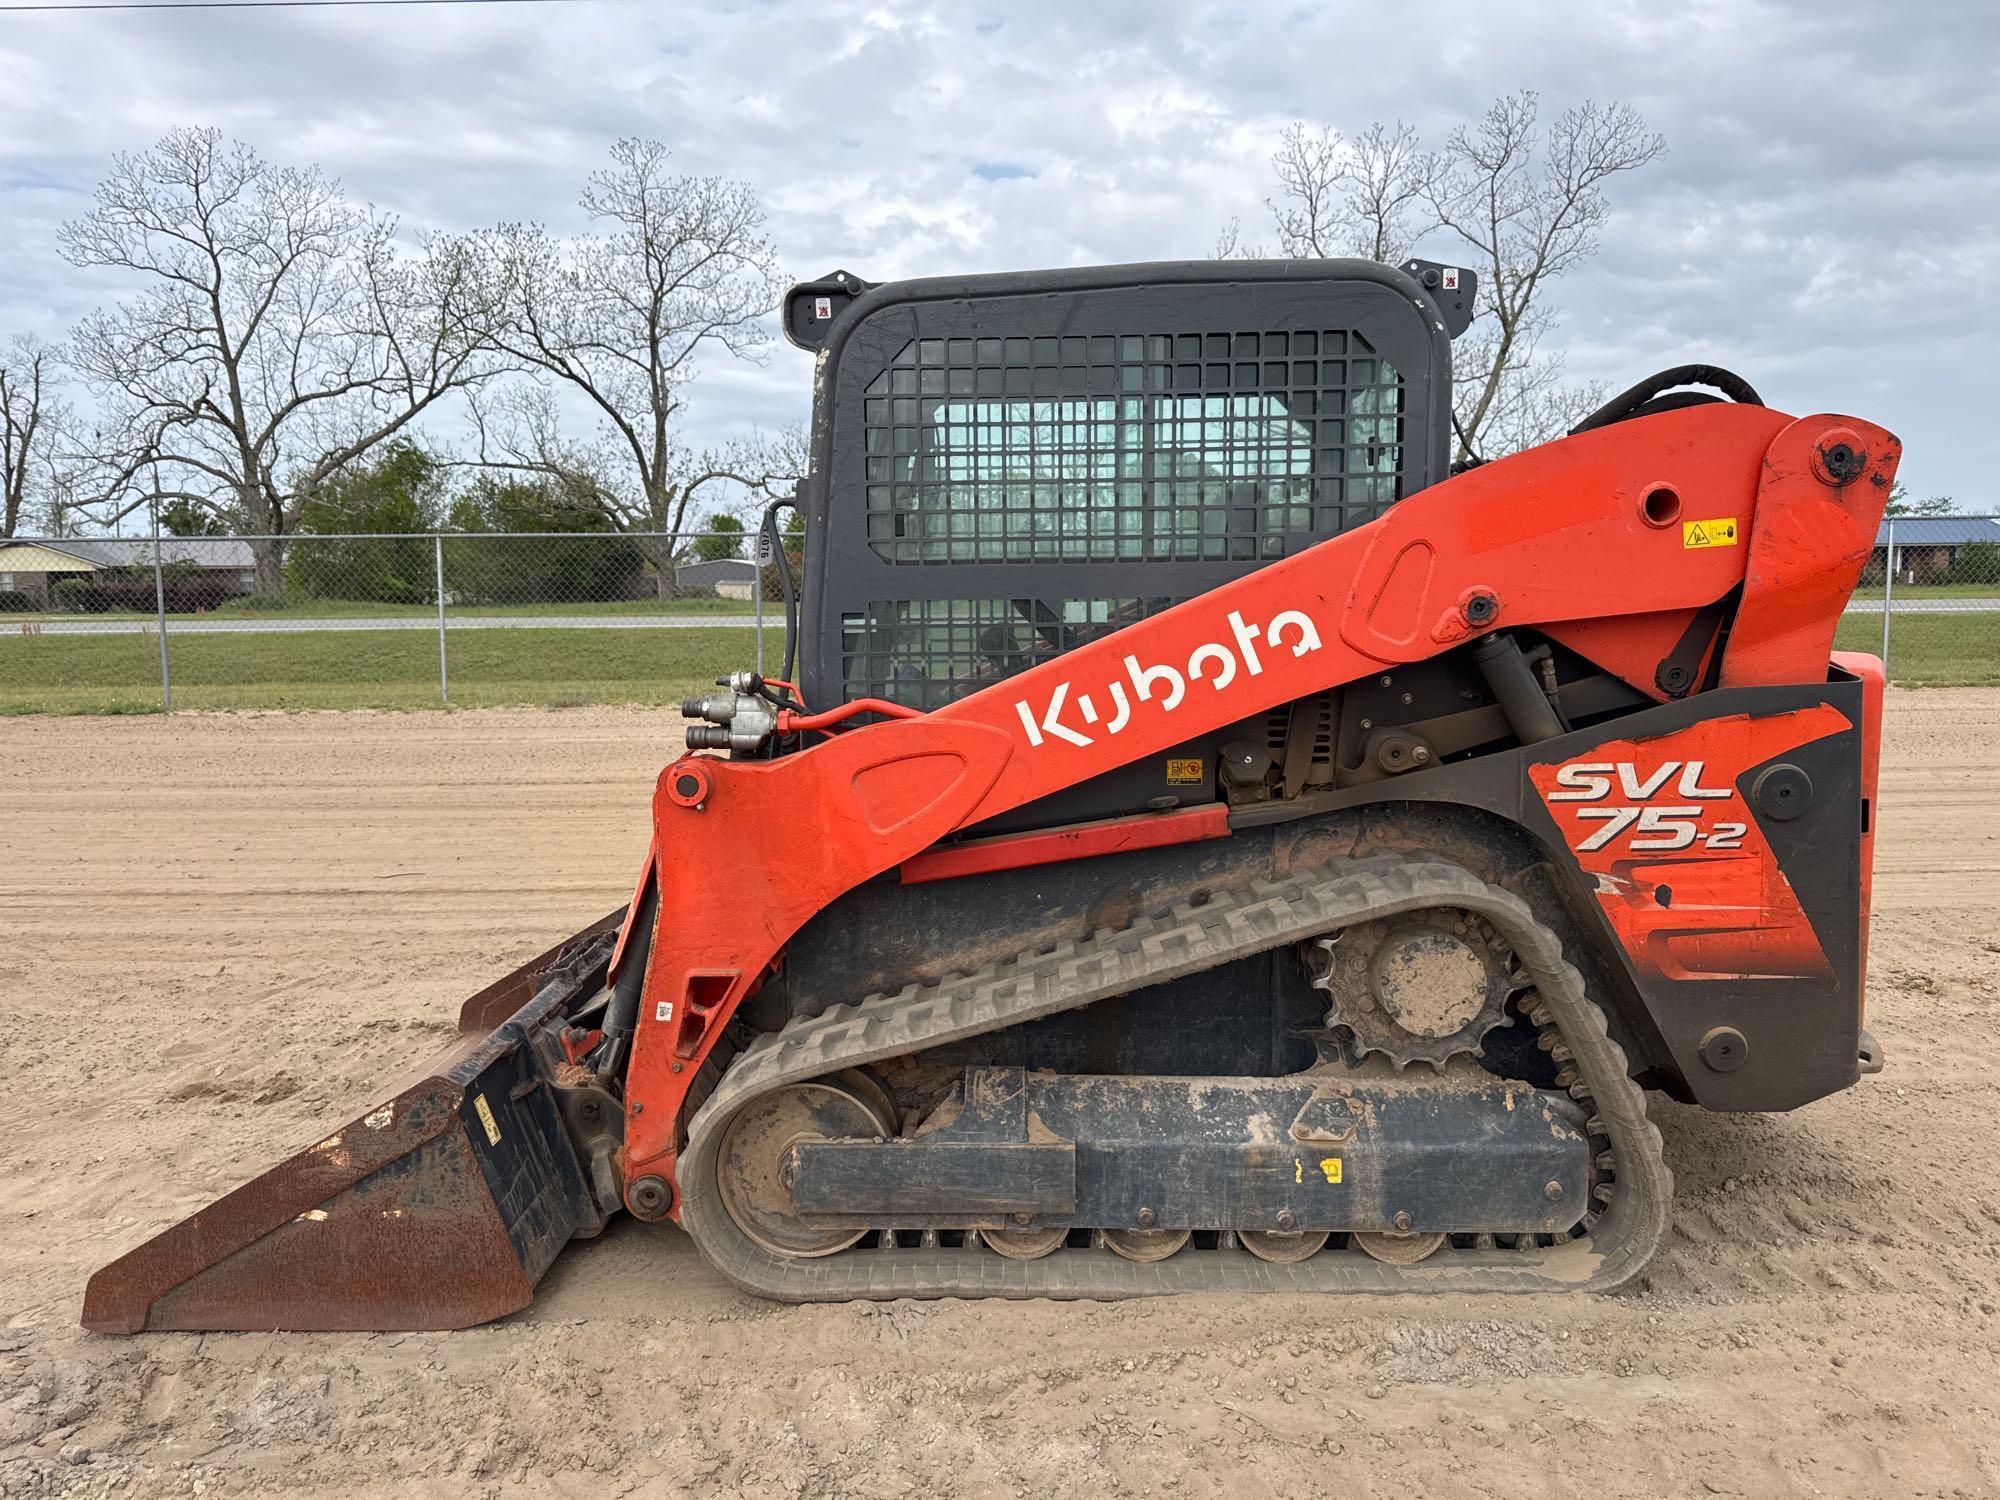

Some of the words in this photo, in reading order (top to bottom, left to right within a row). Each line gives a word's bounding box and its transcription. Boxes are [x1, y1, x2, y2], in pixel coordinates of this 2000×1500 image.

[1015, 610, 1322, 747] Kubota
[1547, 761, 1734, 801] SVL
[1575, 806, 1747, 851] 75-2
